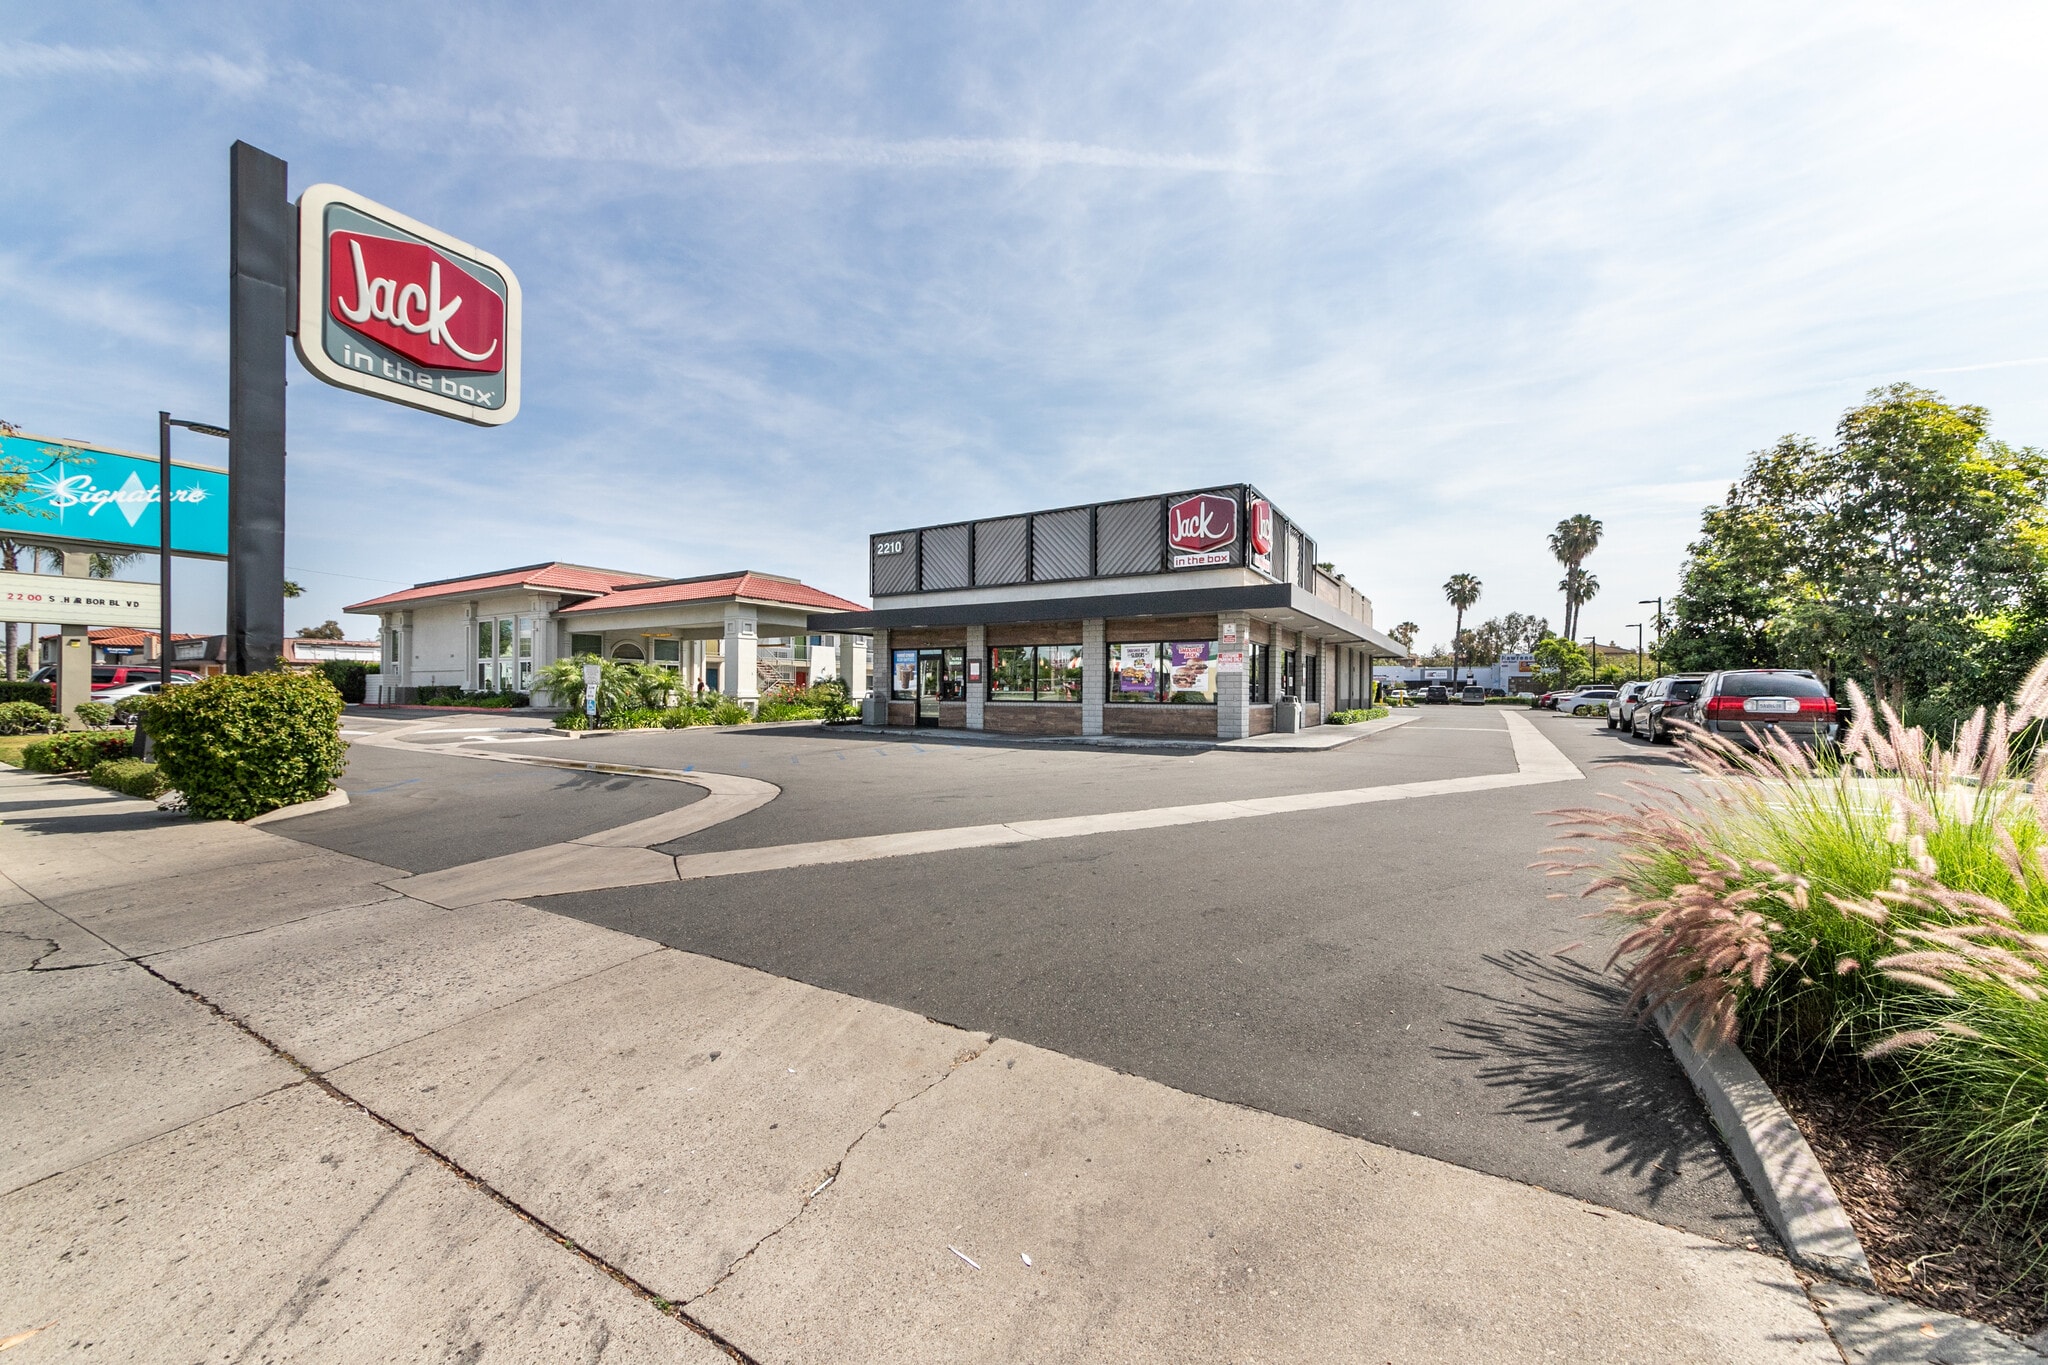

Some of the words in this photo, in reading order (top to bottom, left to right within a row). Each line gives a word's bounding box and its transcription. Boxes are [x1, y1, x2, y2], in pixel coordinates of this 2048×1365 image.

[338, 239, 497, 362] Jack
[343, 344, 374, 372] in
[382, 358, 433, 389] the
[441, 375, 492, 407] box
[49, 475, 206, 516] Signatre
[1172, 501, 1230, 542] Jack
[1258, 505, 1271, 540] Jac
[877, 541, 902, 555] 2210
[1175, 557, 1185, 566] in
[1187, 556, 1205, 565] the
[1207, 554, 1228, 563] box
[7, 592, 42, 601] 2200
